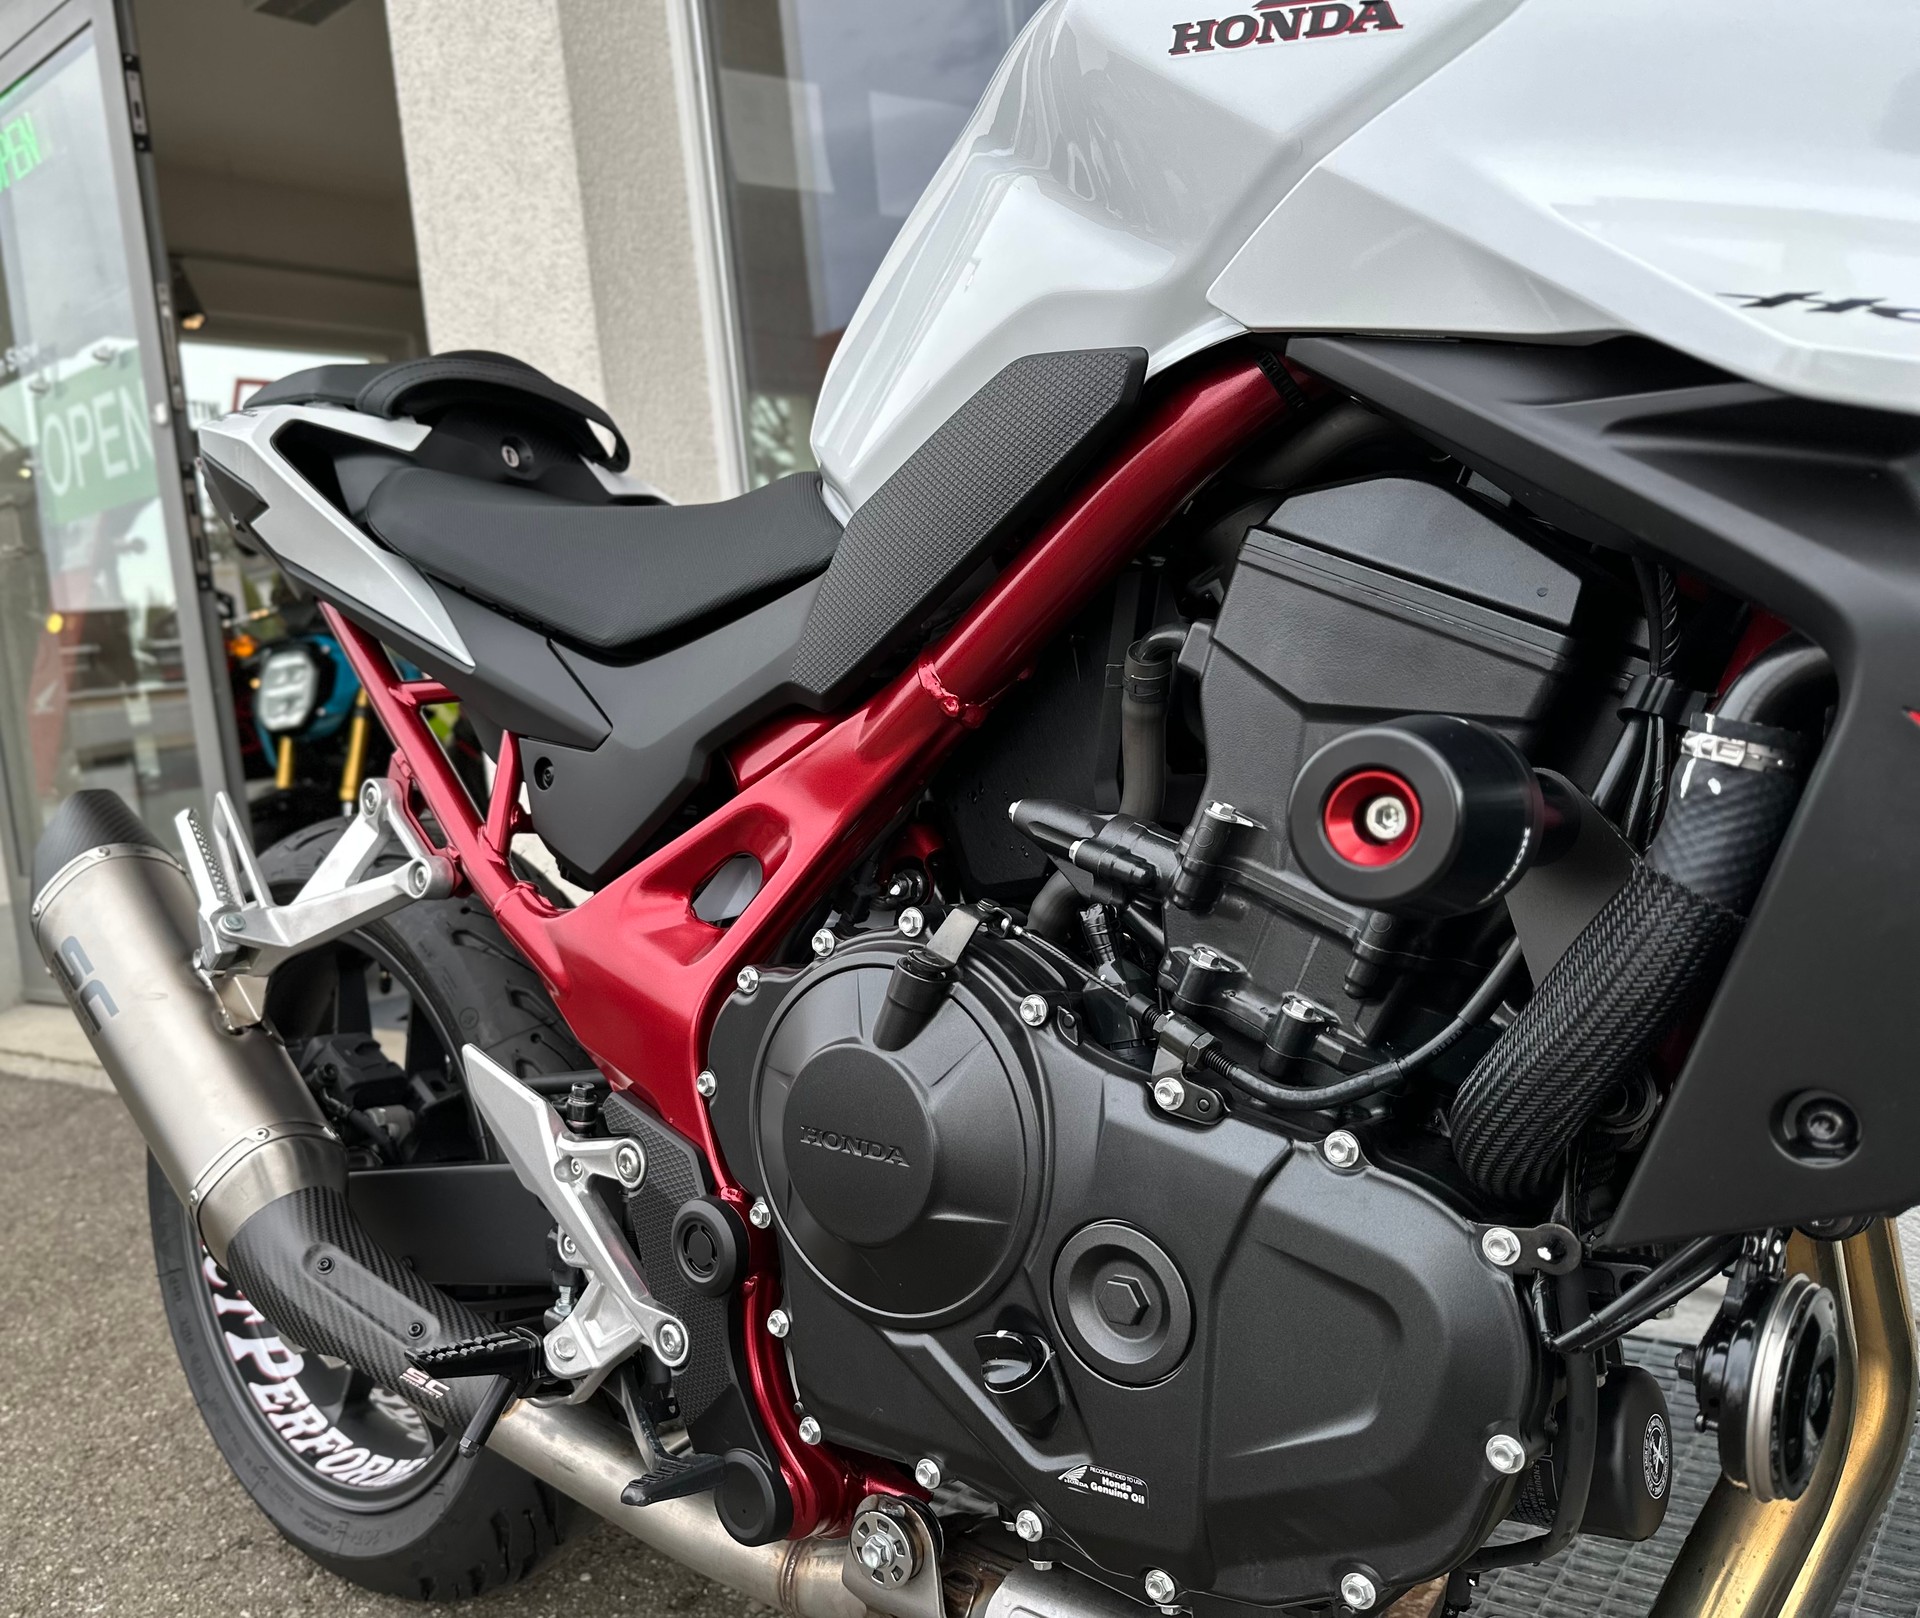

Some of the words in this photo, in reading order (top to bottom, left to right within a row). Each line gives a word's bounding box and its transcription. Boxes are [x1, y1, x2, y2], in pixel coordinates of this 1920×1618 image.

[1168, 0, 1404, 55] HONDA
[0, 111, 43, 192] PEN
[41, 378, 154, 496] OPEN
[799, 1125, 911, 1168] HONDA
[402, 1367, 451, 1397] SC
[1064, 1477, 1089, 1489] HONDA
[1089, 1466, 1127, 1481] RECOMMENDED
[1101, 1476, 1132, 1493] Honda
[1090, 1481, 1129, 1500] Genuine
[1130, 1494, 1145, 1505] Oil
